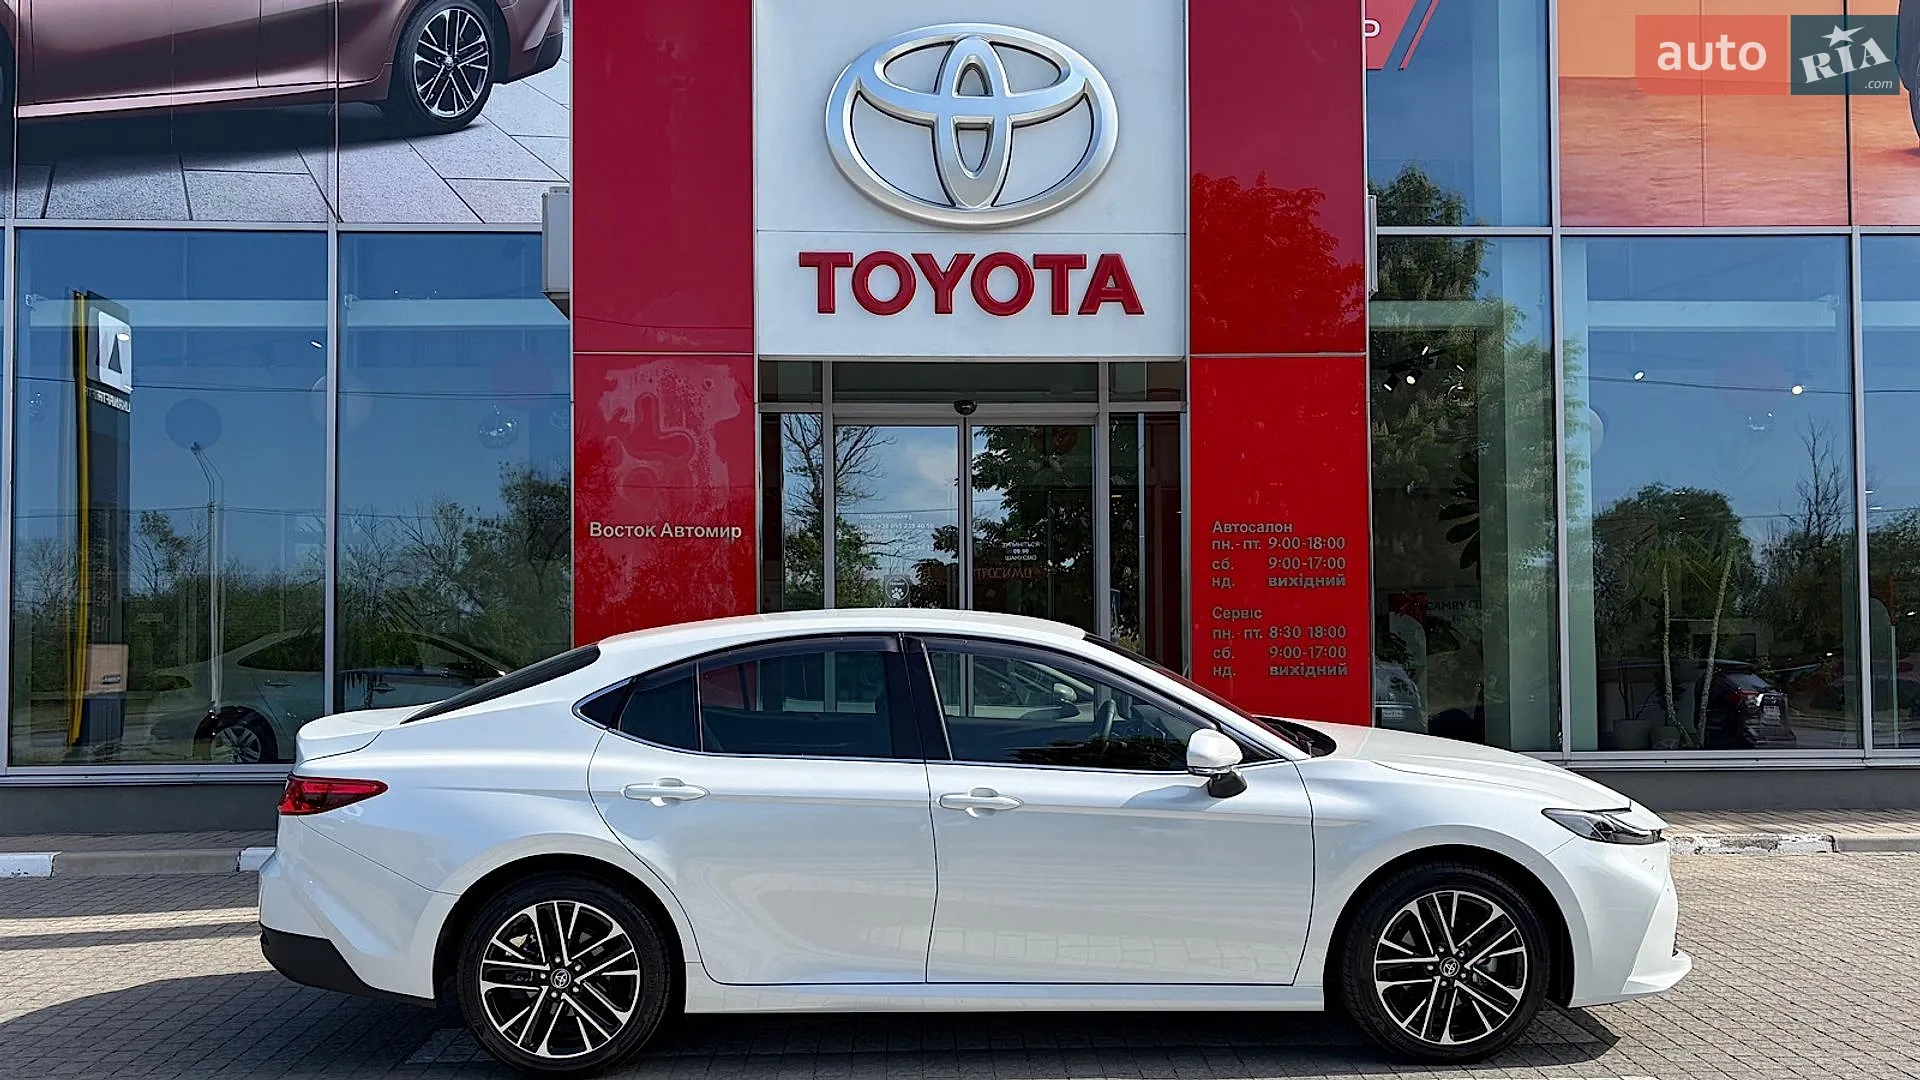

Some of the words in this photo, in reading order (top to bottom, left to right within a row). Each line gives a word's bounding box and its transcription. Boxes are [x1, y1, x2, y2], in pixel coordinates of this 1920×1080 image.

[799, 251, 1145, 316] TOYOTA
[590, 522, 657, 537] Восток
[660, 522, 743, 542] Автомир
[1212, 521, 1293, 533] Автосалон
[1212, 558, 1234, 570] сб.
[1268, 557, 1346, 570] 9:00-17:00
[1212, 577, 1235, 589] нд.
[1268, 573, 1347, 588] вихідний
[1212, 606, 1264, 622] Сервіс
[1213, 648, 1235, 659] сб.
[1269, 645, 1347, 659] 9:00-17:00
[1213, 667, 1236, 678] нд.
[1270, 662, 1348, 677] вихідний
